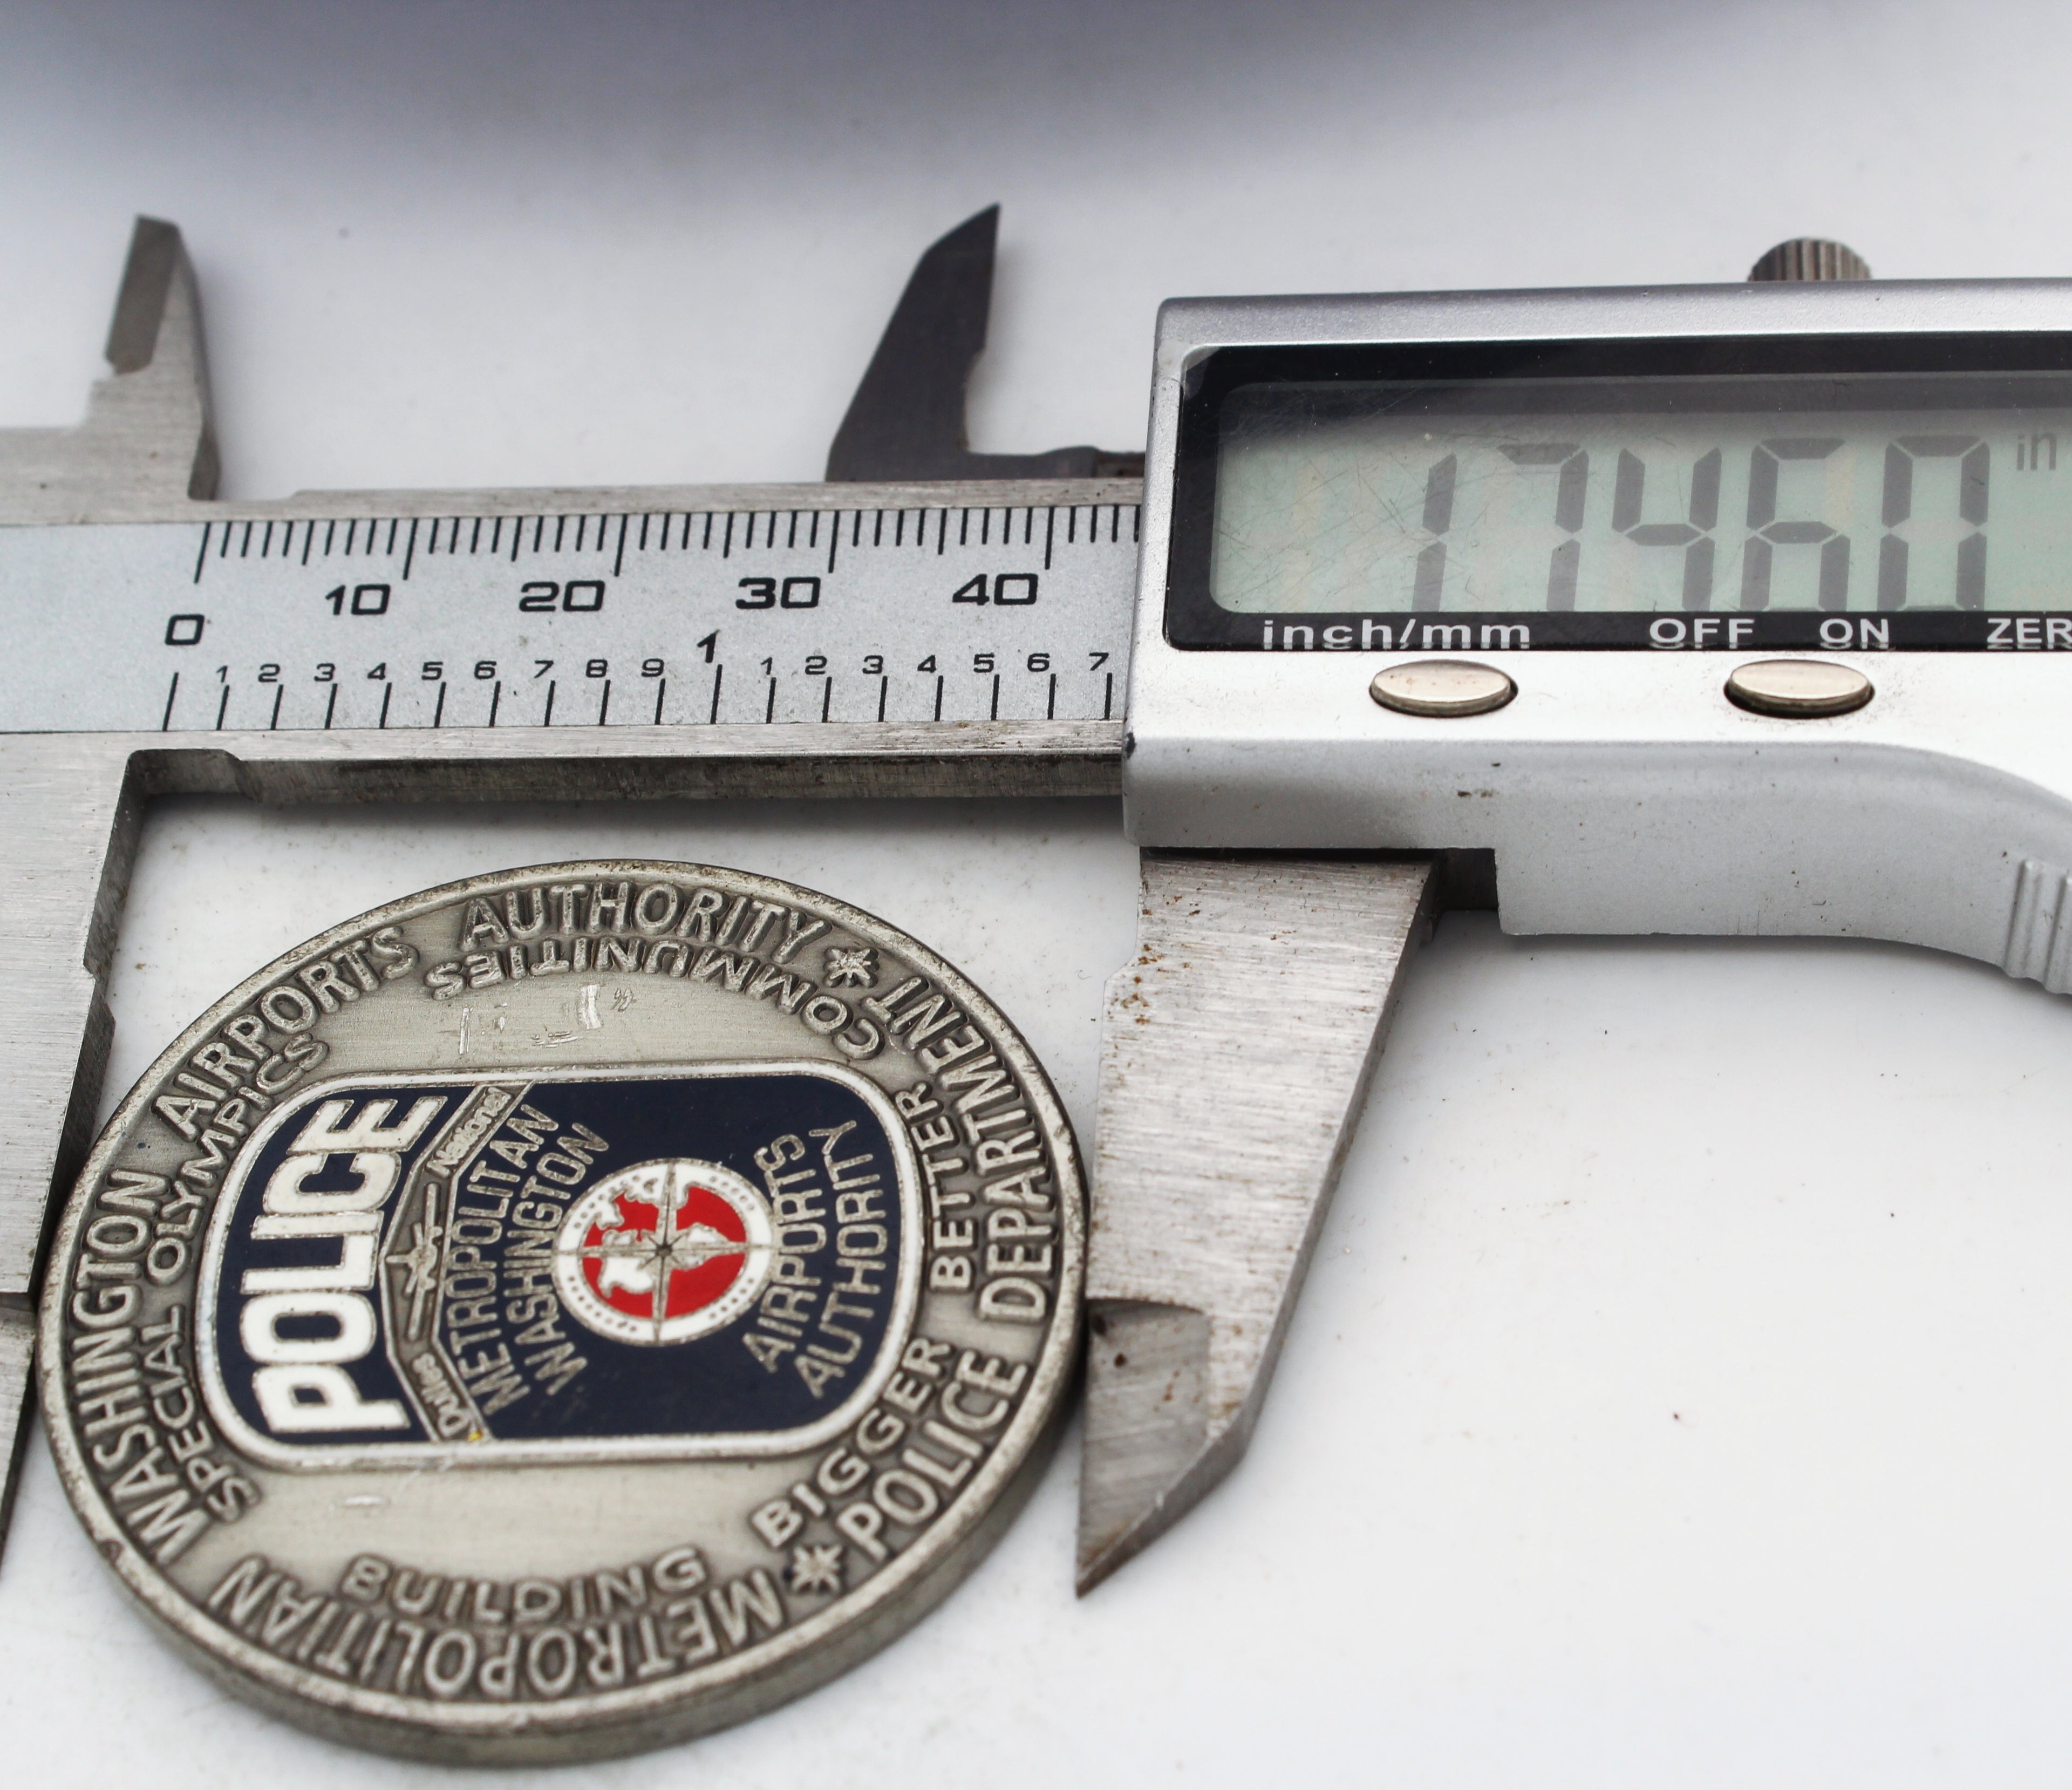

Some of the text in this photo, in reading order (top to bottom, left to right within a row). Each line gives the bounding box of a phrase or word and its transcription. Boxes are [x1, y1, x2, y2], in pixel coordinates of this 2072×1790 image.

[2017, 433, 2057, 471] in
[165, 573, 1038, 645] 0 10 20 30 40
[217, 630, 1109, 683] 1 2 3 4 5 6 7 8 9 1 1 2 3 4 5 6 7
[1263, 618, 1530, 646] inch/mm
[1649, 618, 1755, 645] OFF
[1819, 618, 1890, 645] ON
[240, 1095, 448, 1432] POLICE
[426, 1087, 512, 1177] National
[445, 1104, 558, 1415] METROPOLITAN
[503, 1122, 609, 1396] WASHINGTON
[743, 1134, 827, 1373] AIRPORTS
[794, 1120, 888, 1399] AUTHORITY
[836, 976, 1056, 1560] POLICE DEPARTMENT
[71, 881, 831, 1694] METROPOLITAN WASHINGTON AIRPORTS AUTHORITY
[141, 1032, 329, 1522] SPECIAL OLYMPICS
[343, 937, 976, 1621] BUILDING BIGGER BETTER COMMUNITIES
